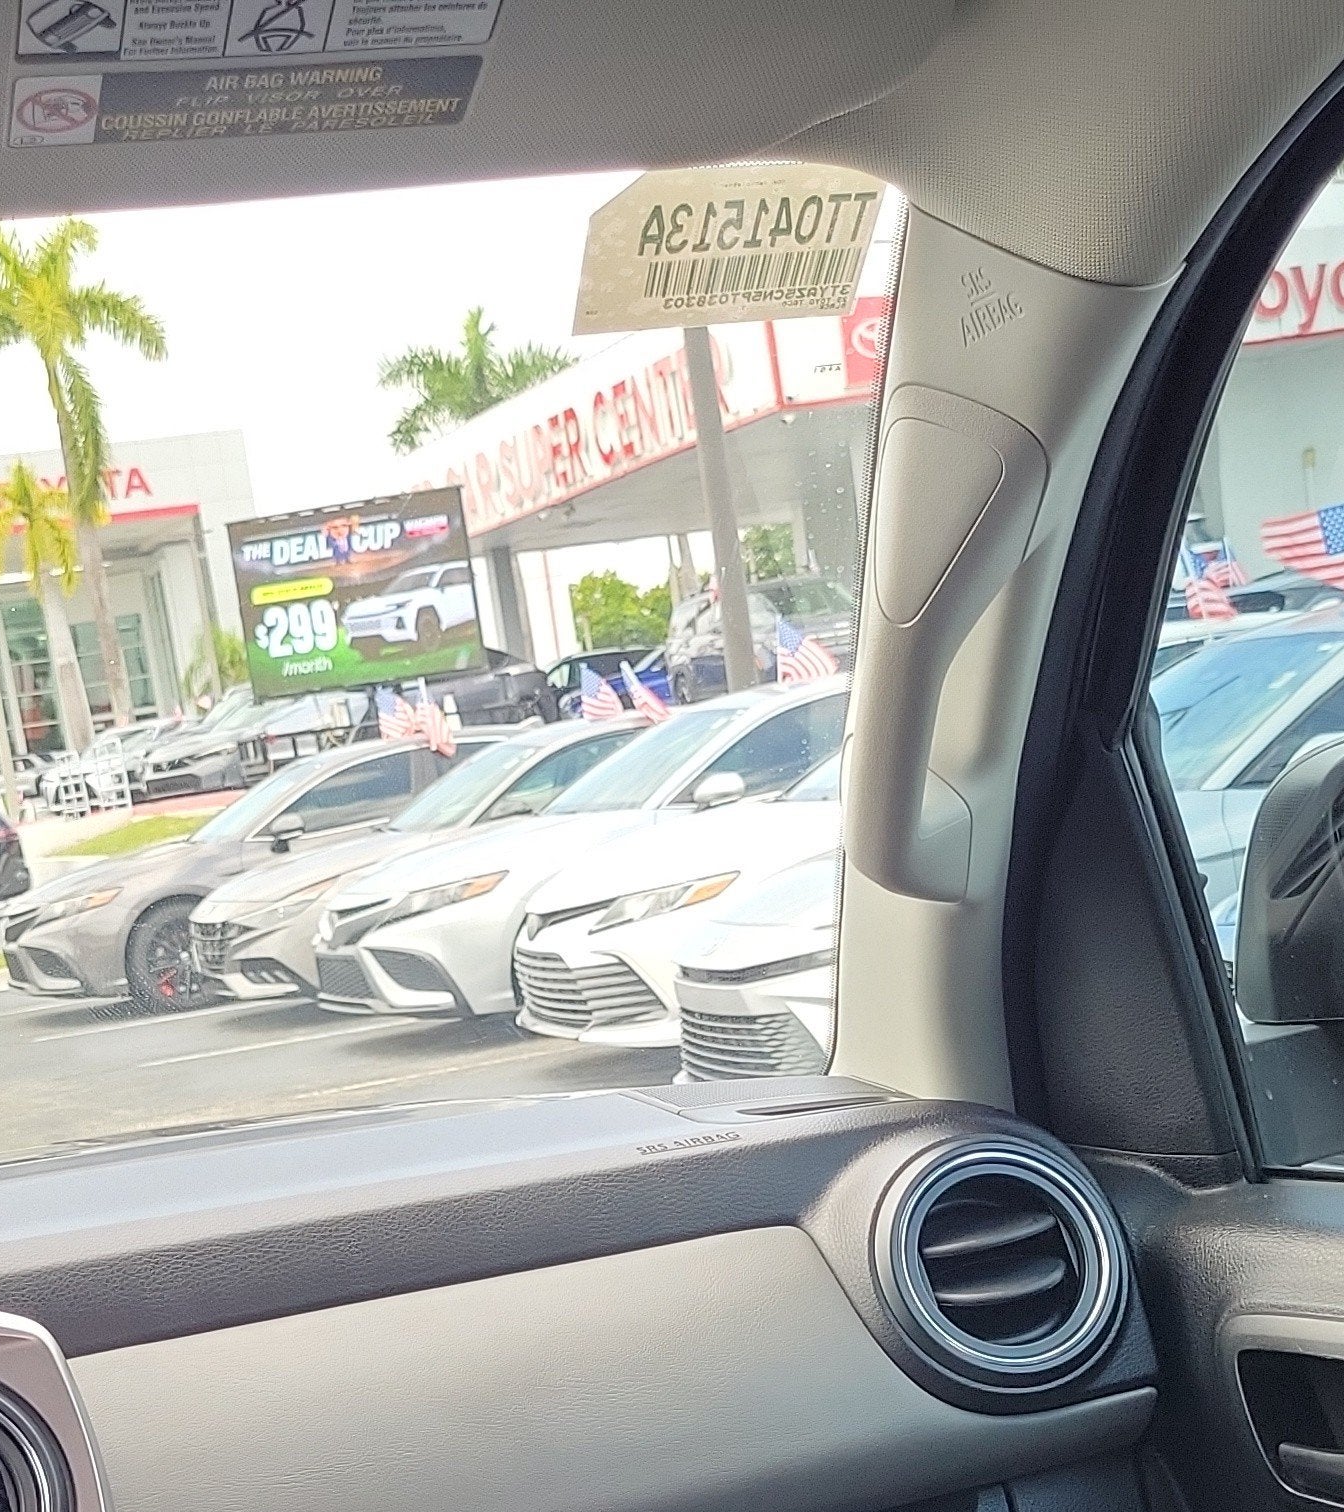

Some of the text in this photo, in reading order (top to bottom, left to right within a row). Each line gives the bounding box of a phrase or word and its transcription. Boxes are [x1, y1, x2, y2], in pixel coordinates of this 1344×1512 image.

[206, 67, 383, 92] AIR BAG WARNING
[337, 85, 404, 99] OVER
[101, 98, 461, 131] COUSSIN GONFLABLE AVERTISSEMENT
[123, 125, 228, 142] REPLIER
[961, 292, 1026, 347] AIRBAG
[499, 407, 591, 508] SUPER
[241, 541, 271, 562] THE
[271, 529, 334, 566] DEAL
[349, 520, 401, 553] CUP
[254, 598, 338, 659] $299
[636, 1131, 741, 1154] SRS AIRBAG
